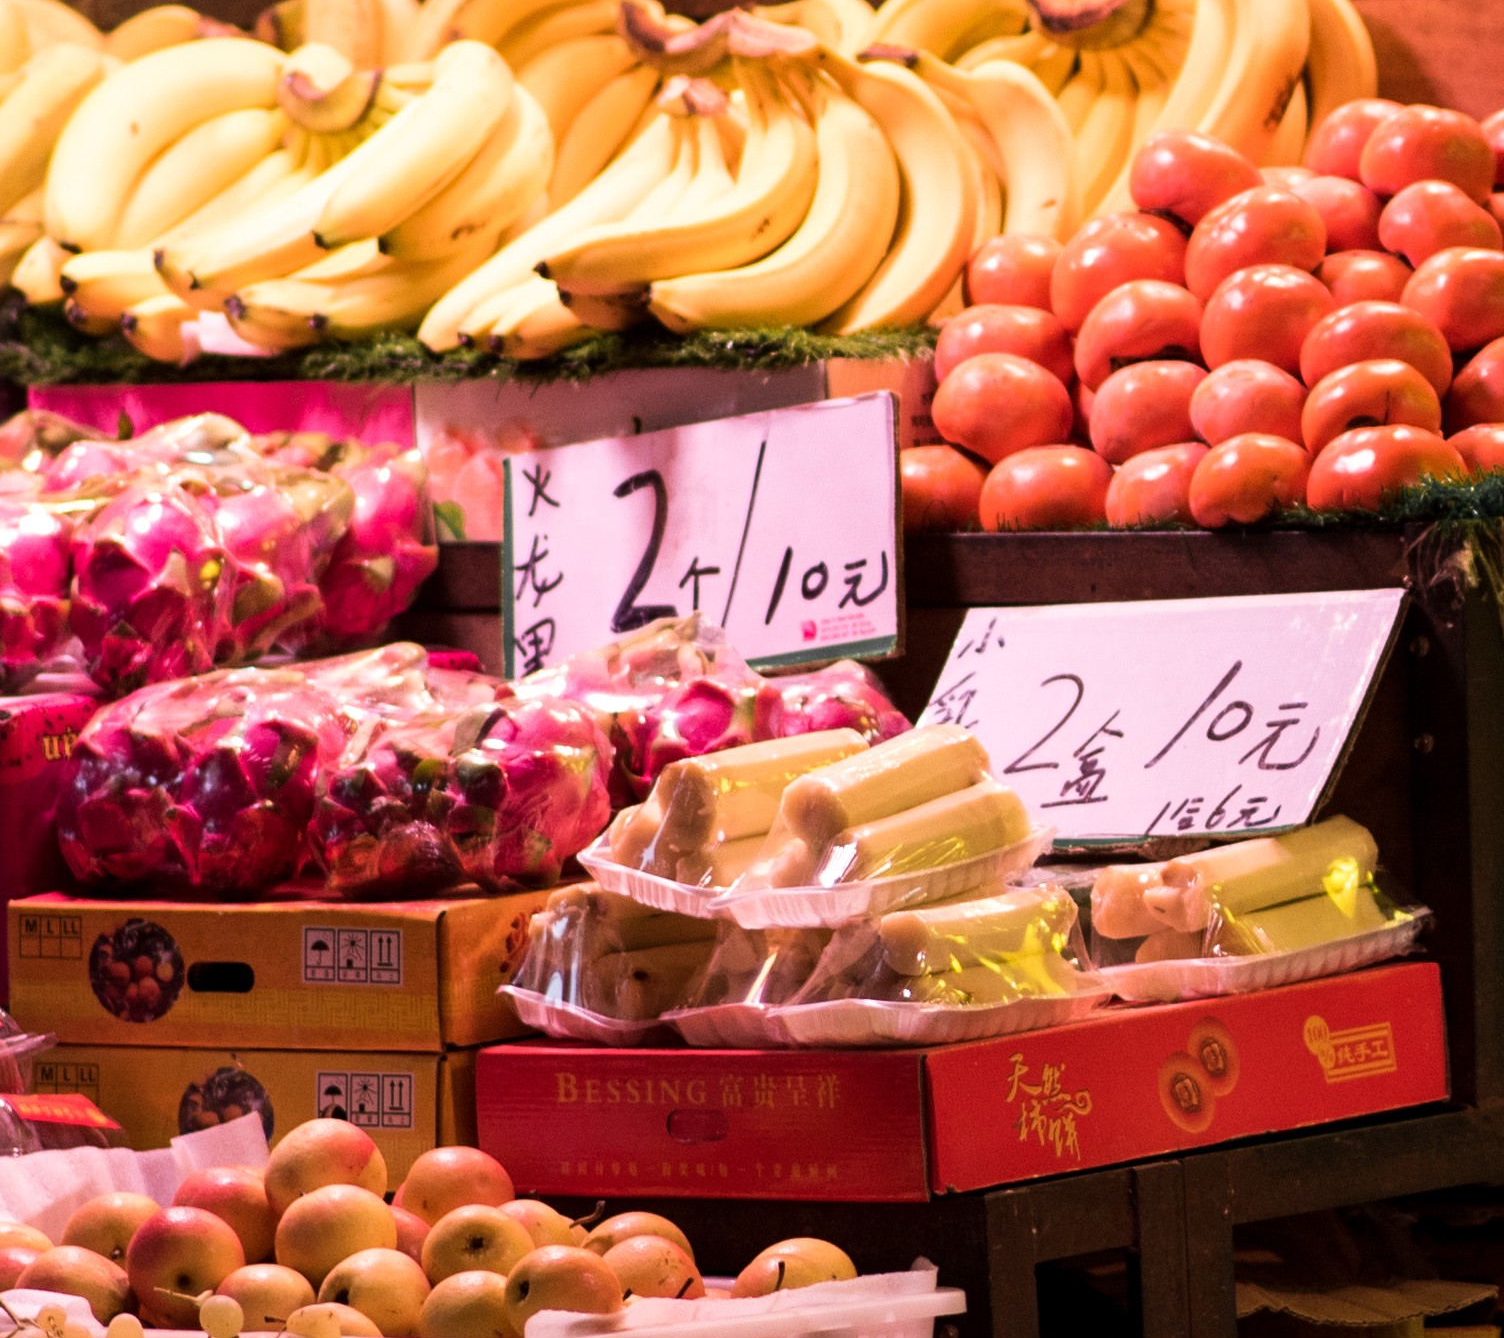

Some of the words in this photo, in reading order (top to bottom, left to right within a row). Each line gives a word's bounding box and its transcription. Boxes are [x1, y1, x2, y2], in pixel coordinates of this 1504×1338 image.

[24, 919, 37, 934] M
[46, 920, 54, 934] L
[62, 921, 79, 935] LL
[1337, 1039, 1389, 1066] 纯手工
[41, 1067, 53, 1081] M
[63, 1067, 71, 1082] L
[80, 1068, 95, 1083] LL
